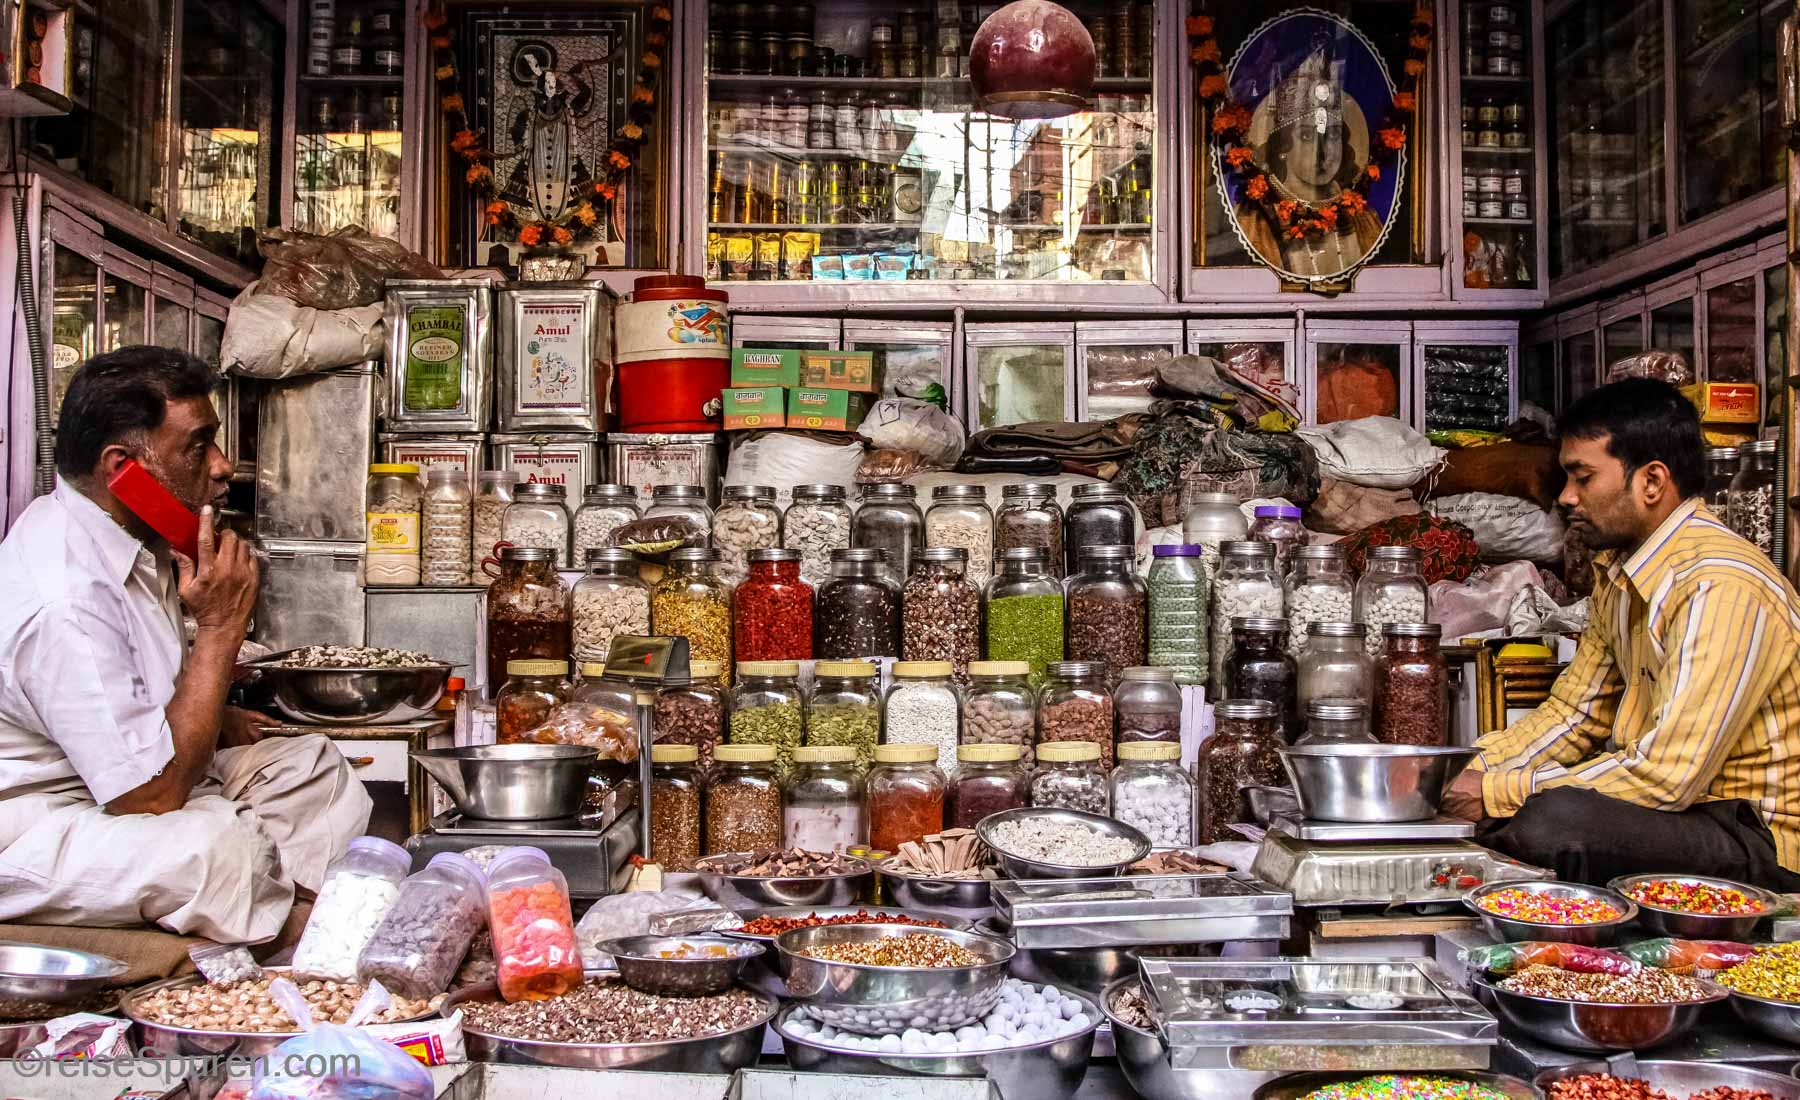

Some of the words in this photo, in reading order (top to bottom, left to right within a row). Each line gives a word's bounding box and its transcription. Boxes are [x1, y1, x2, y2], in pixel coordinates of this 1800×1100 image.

[411, 319, 462, 332] CHAMBAL
[534, 324, 570, 335] Amul
[527, 472, 565, 485] Amul
